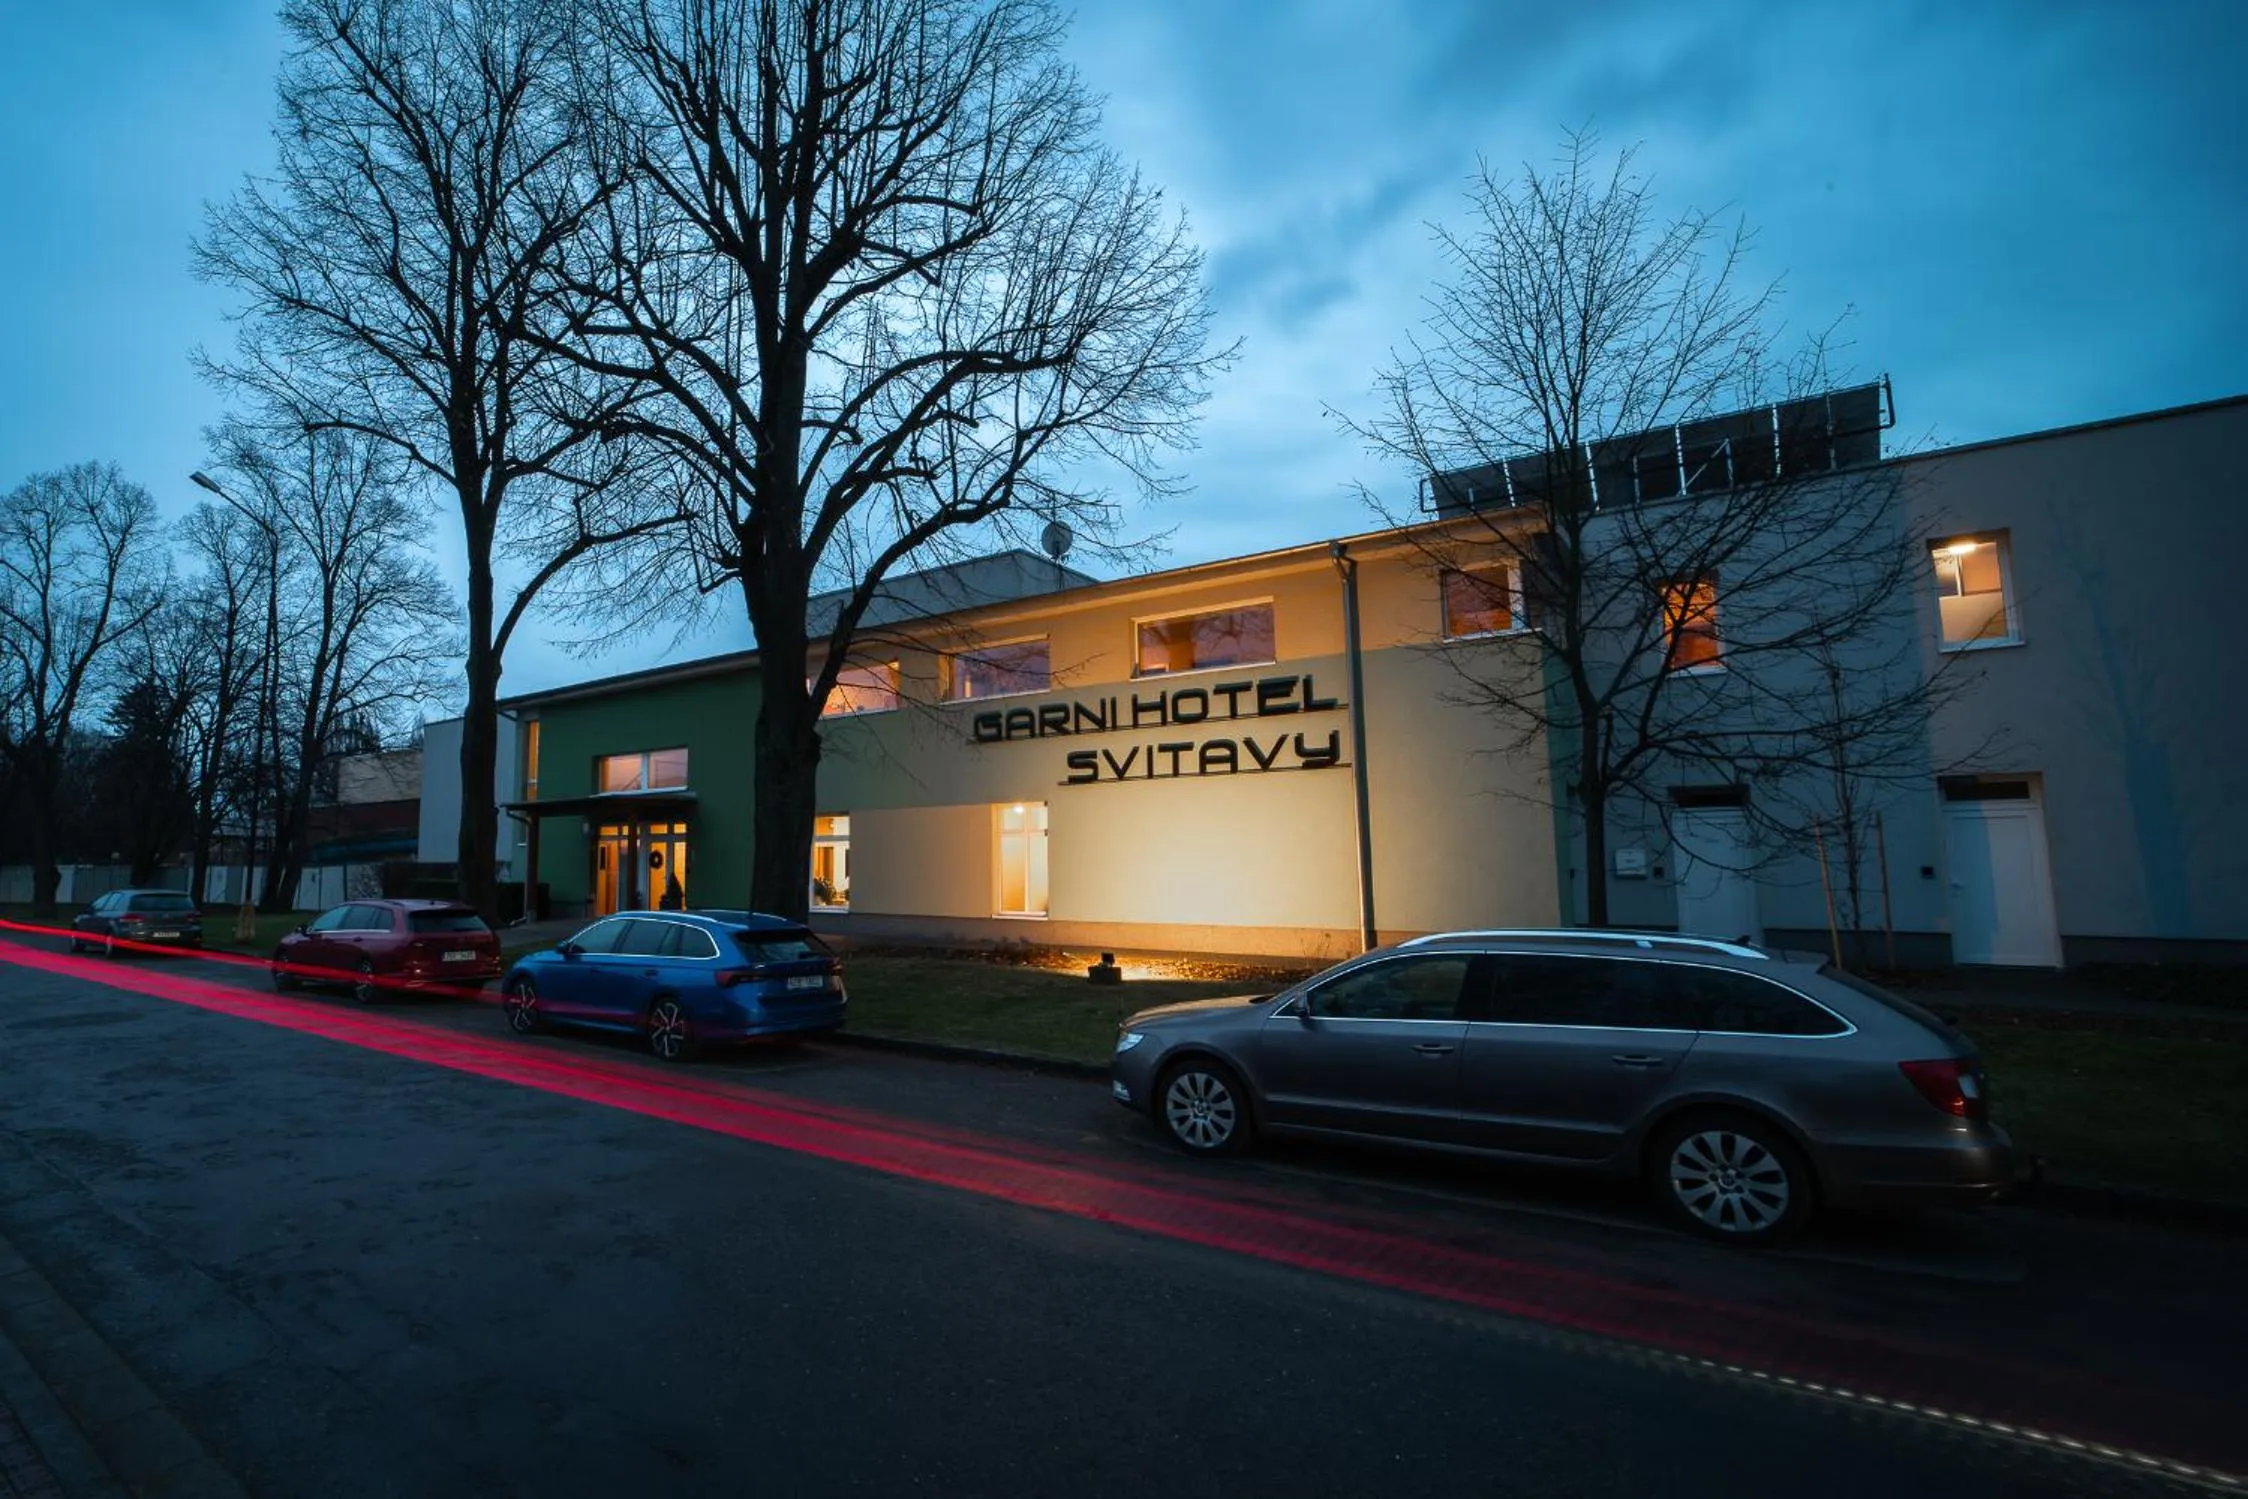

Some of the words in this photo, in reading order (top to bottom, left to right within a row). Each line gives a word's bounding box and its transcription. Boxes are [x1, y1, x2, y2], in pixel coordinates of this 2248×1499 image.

[974, 696, 1117, 741] GARNI
[1132, 674, 1338, 729] HOTEL
[1066, 730, 1340, 784] SVITAVY
